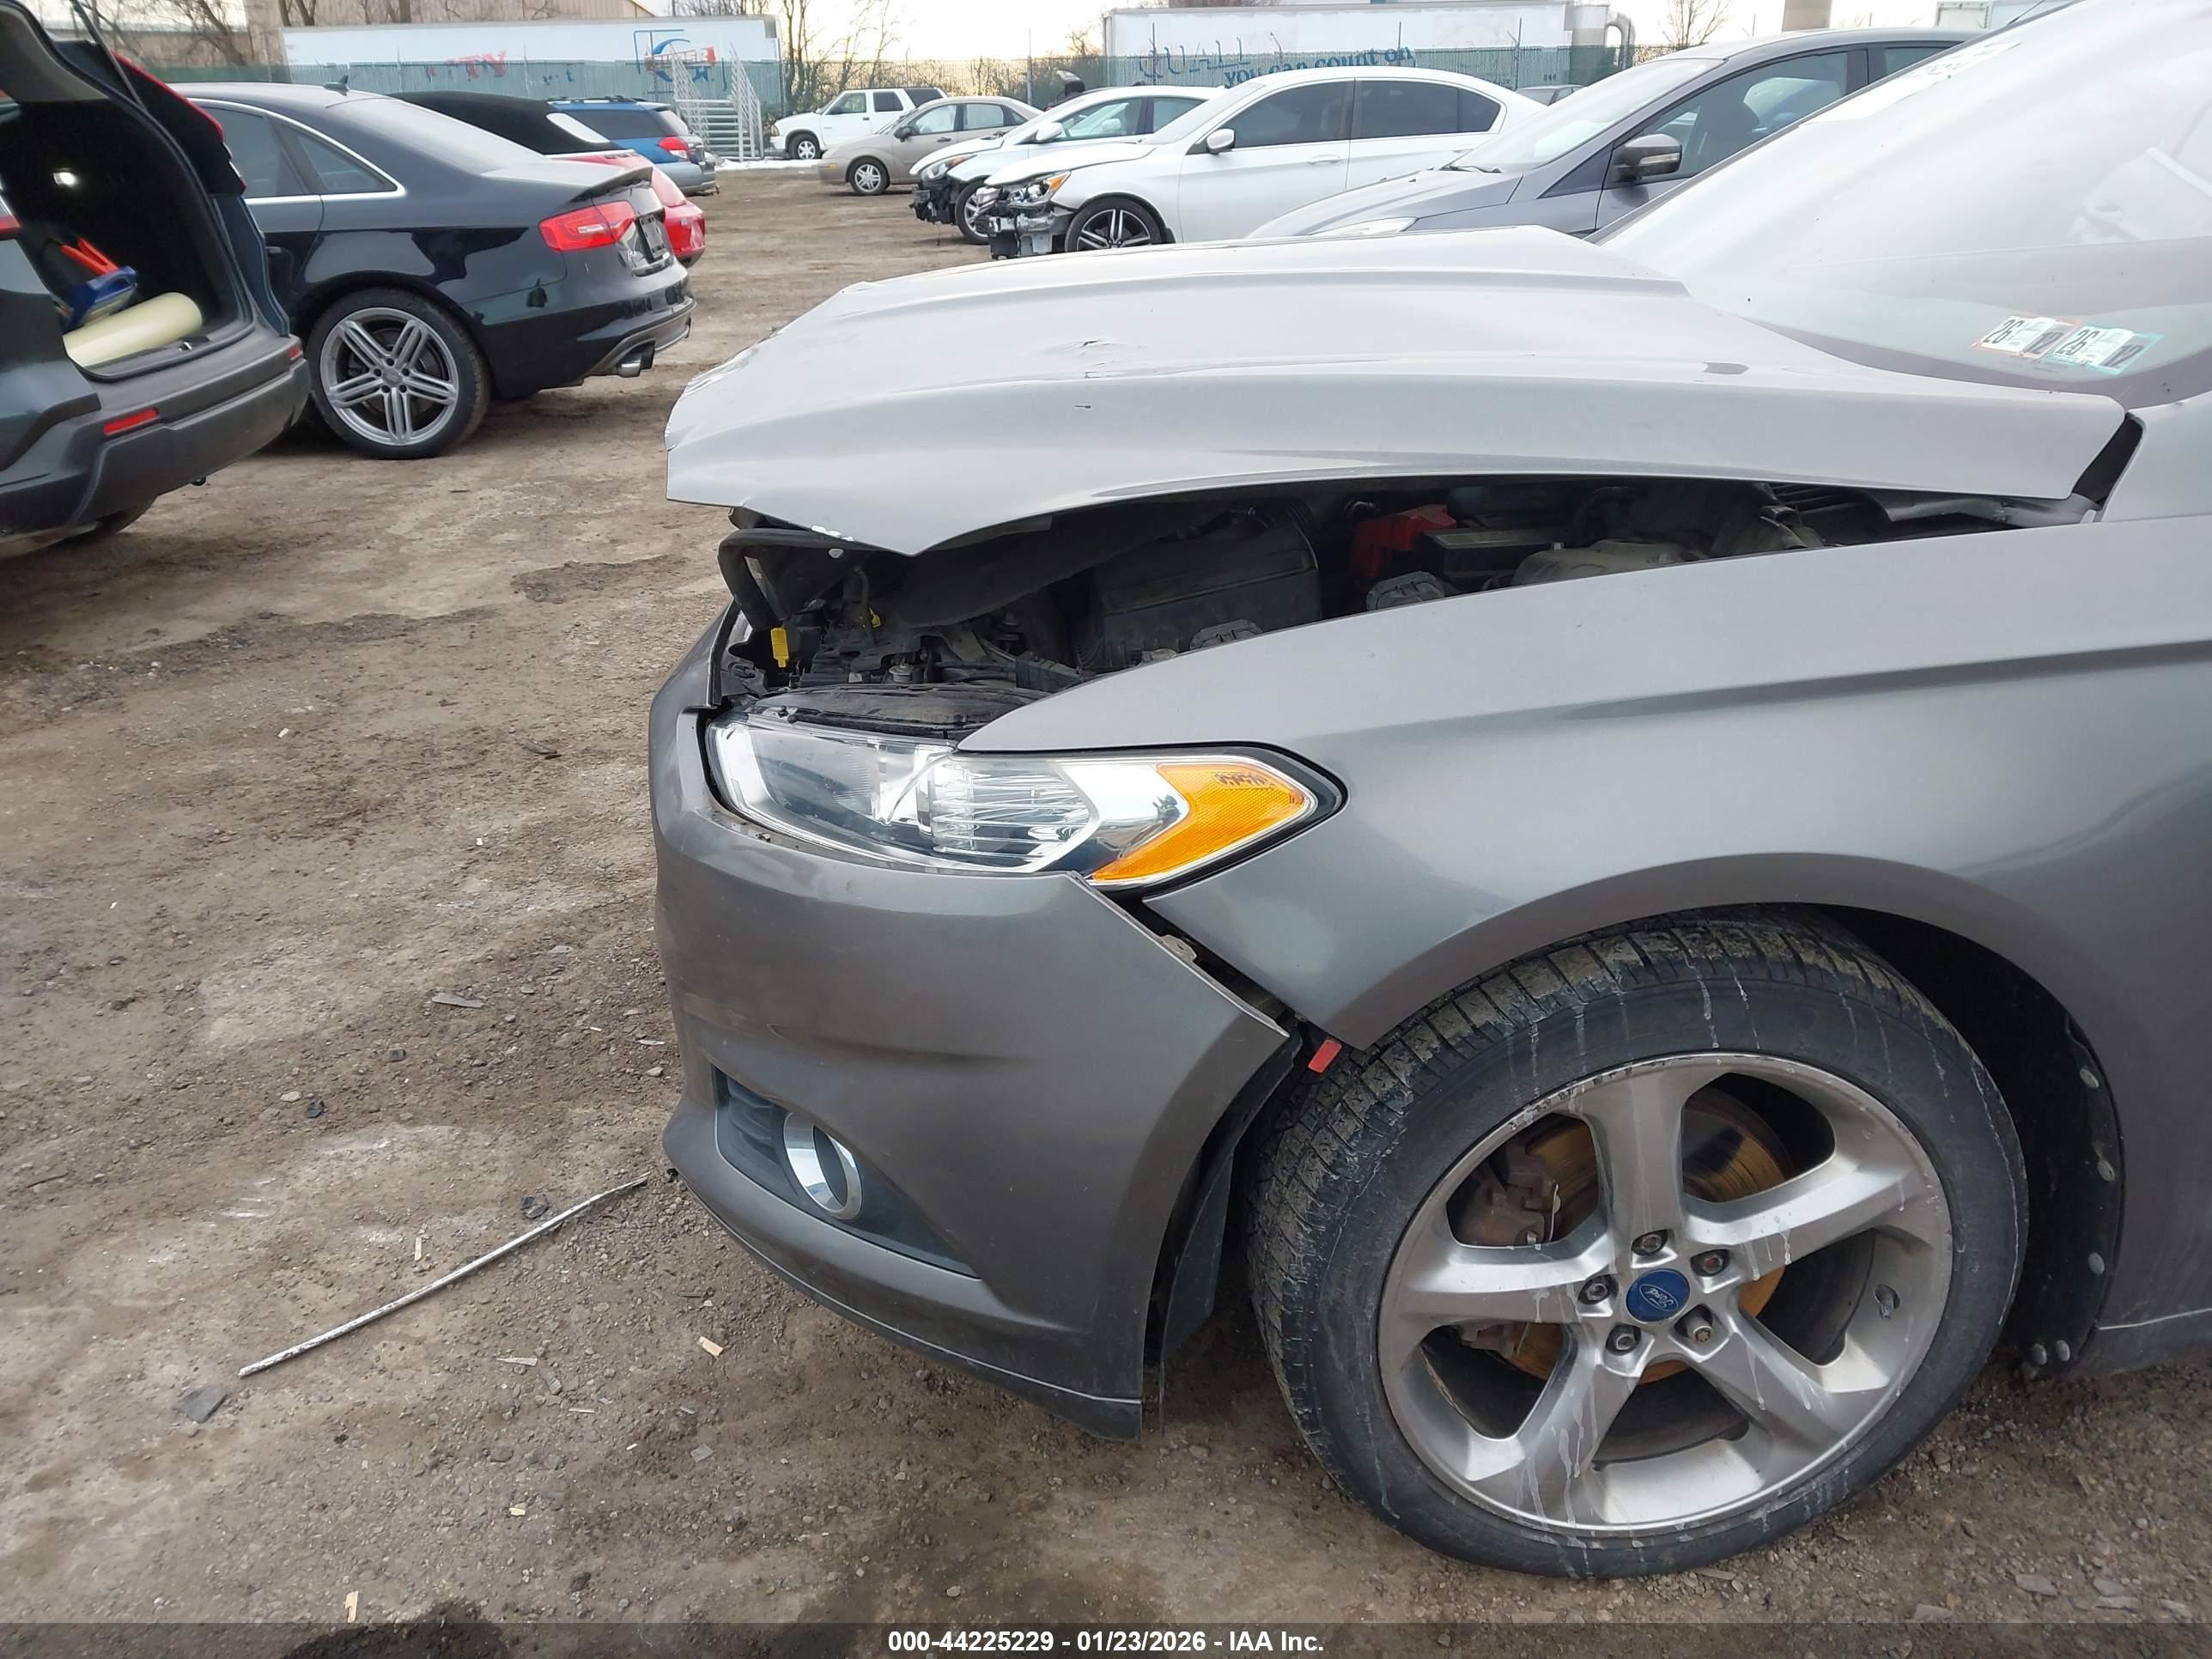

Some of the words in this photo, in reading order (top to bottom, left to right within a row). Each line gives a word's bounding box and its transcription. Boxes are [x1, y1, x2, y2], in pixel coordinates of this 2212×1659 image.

[1314, 47, 1377, 67] count
[1384, 46, 1414, 63] on
[1644, 1286, 1675, 1310] Ford
